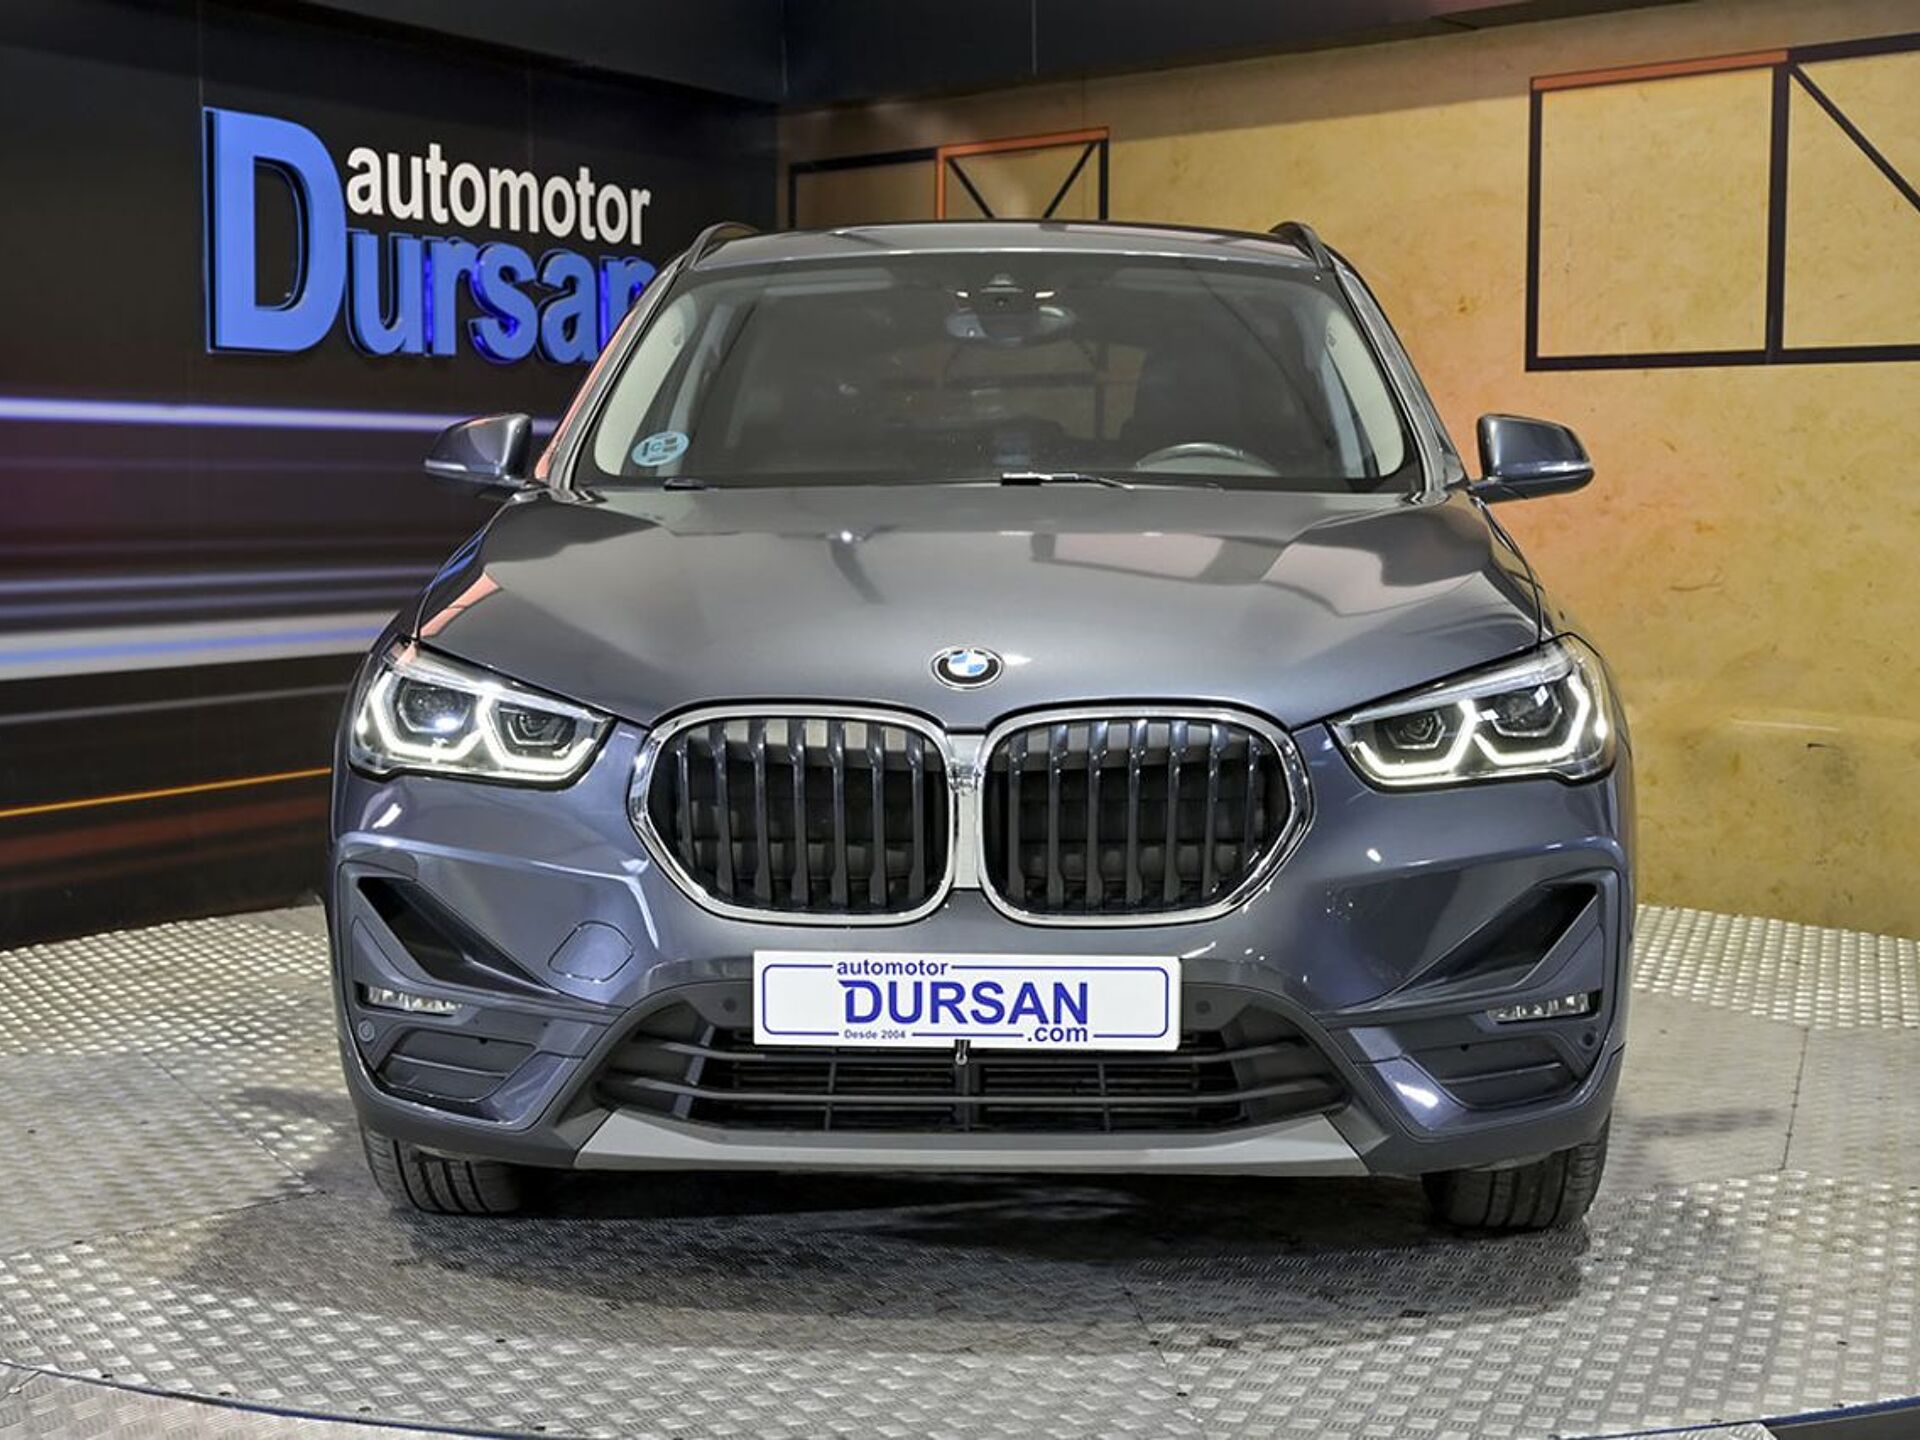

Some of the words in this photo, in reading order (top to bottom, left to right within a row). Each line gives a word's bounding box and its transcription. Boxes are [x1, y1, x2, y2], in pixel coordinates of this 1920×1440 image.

[346, 143, 651, 246] automotor
[836, 960, 948, 976] automotor
[838, 980, 1088, 1025] DURSAN
[844, 1029, 877, 1039] Desde
[1027, 1026, 1088, 1042] .com
